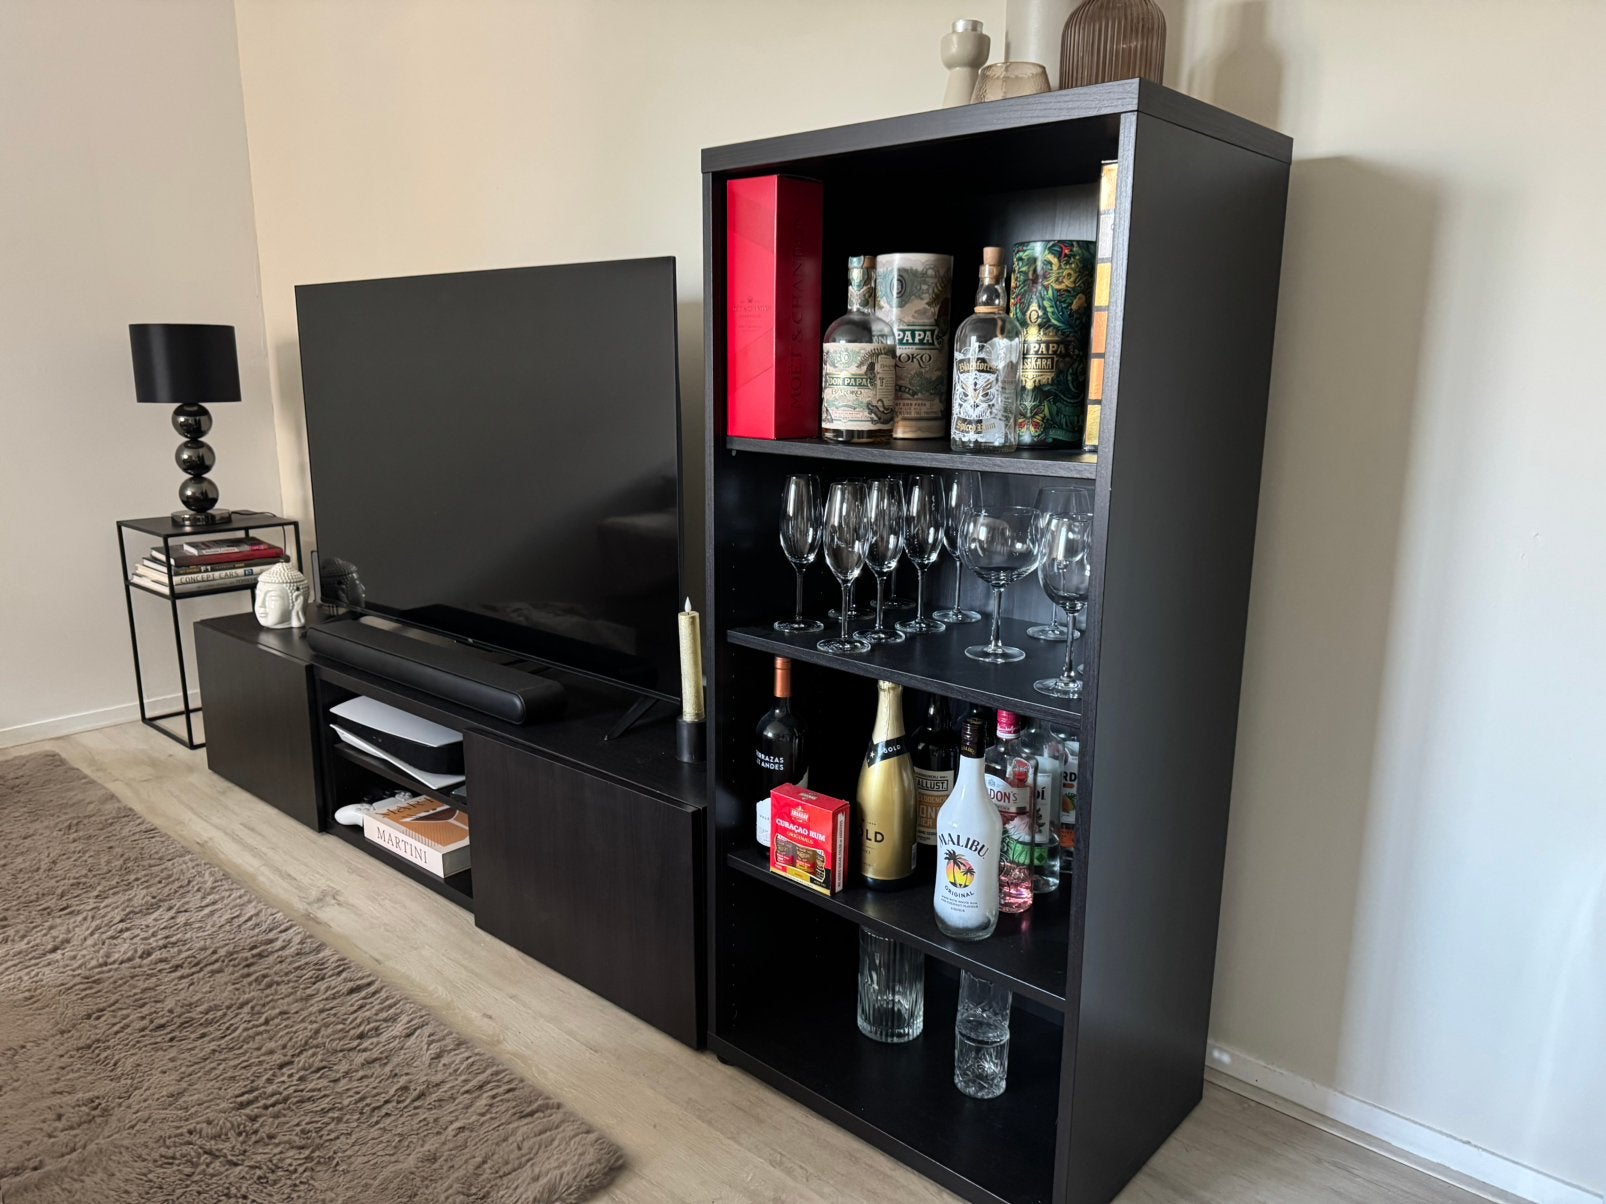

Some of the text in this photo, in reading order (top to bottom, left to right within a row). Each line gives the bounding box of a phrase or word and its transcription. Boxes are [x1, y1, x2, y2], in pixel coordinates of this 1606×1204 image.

[897, 330, 933, 343] PAPA
[1029, 343, 1066, 354] PAPA
[1023, 357, 1052, 370] SSKARA
[844, 377, 867, 386] PAPA
[180, 573, 216, 584] CONCEPT
[219, 571, 239, 580] CARS
[883, 744, 902, 754] GOLD
[989, 788, 1018, 803] DON'S
[776, 818, 826, 842] CURAÇAO RUM
[376, 826, 428, 864] MARTINI
[939, 832, 989, 858] MALIBU
[945, 885, 975, 898] ORIGINAL
